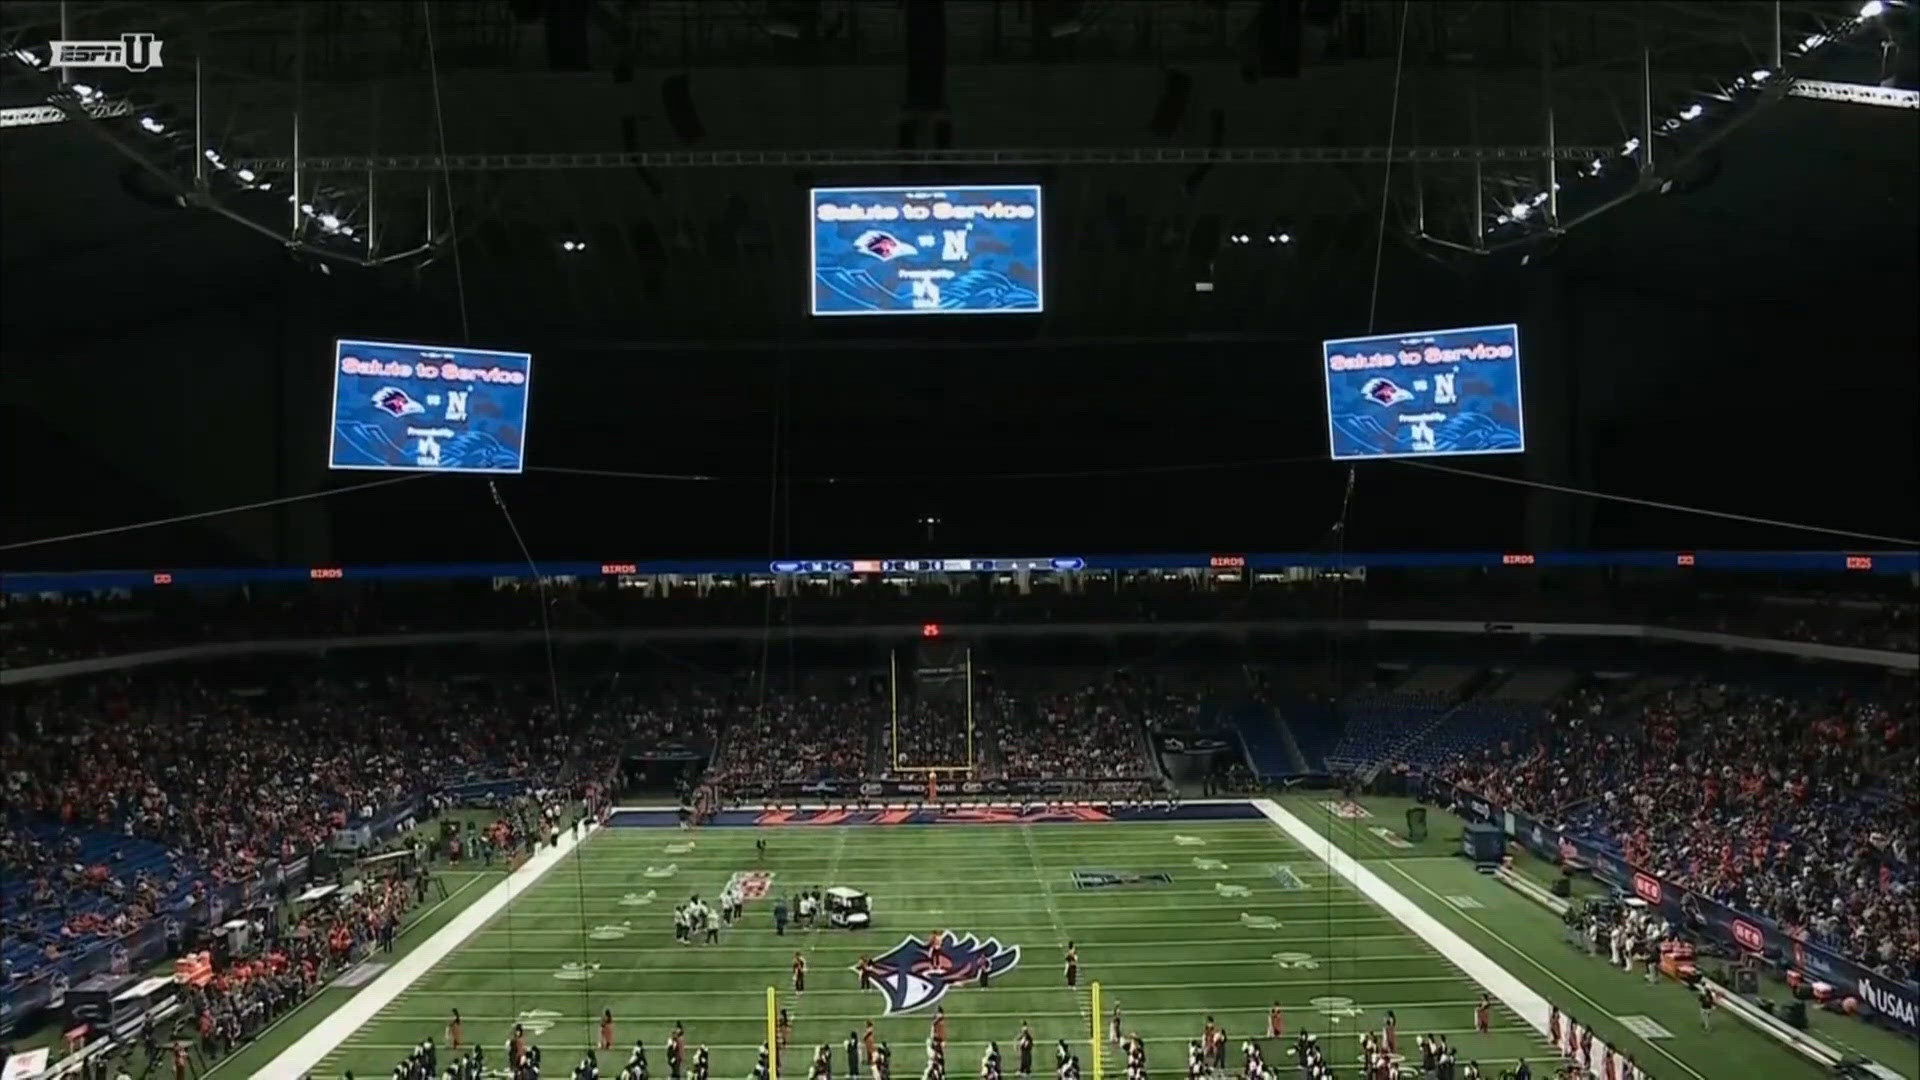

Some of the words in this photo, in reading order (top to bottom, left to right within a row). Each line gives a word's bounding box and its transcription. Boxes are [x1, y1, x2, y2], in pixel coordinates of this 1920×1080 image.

[817, 204, 899, 221] Salute
[902, 203, 931, 220] to
[932, 201, 1035, 221] Service
[1329, 352, 1396, 371] Salute
[1398, 350, 1422, 366] to
[1424, 343, 1514, 365] Service
[341, 356, 413, 379] Salute
[415, 362, 440, 380] to
[441, 363, 525, 385] Service
[1210, 557, 1245, 568] BIRDS
[1503, 555, 1534, 565] BIRDS
[311, 568, 343, 579] BIRDS
[602, 564, 636, 575] BIRDS
[1877, 987, 1916, 1028] USAA
